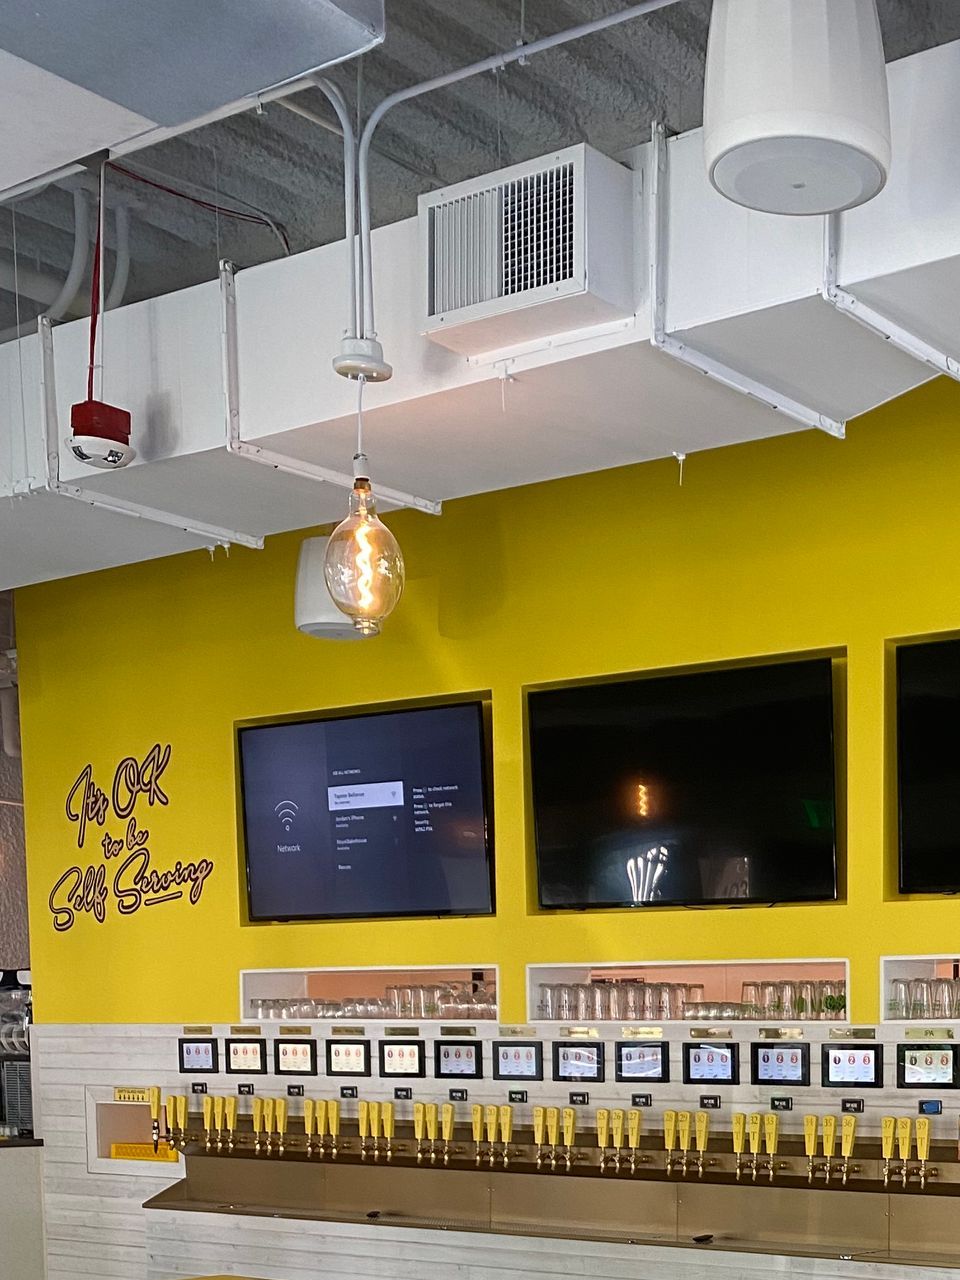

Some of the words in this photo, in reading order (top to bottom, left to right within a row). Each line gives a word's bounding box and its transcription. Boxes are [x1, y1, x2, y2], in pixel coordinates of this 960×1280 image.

[112, 743, 171, 819] OK
[102, 832, 123, 859] to
[126, 816, 149, 850] be
[277, 844, 301, 852] Network
[49, 864, 107, 932] Self
[113, 847, 213, 914] Serving
